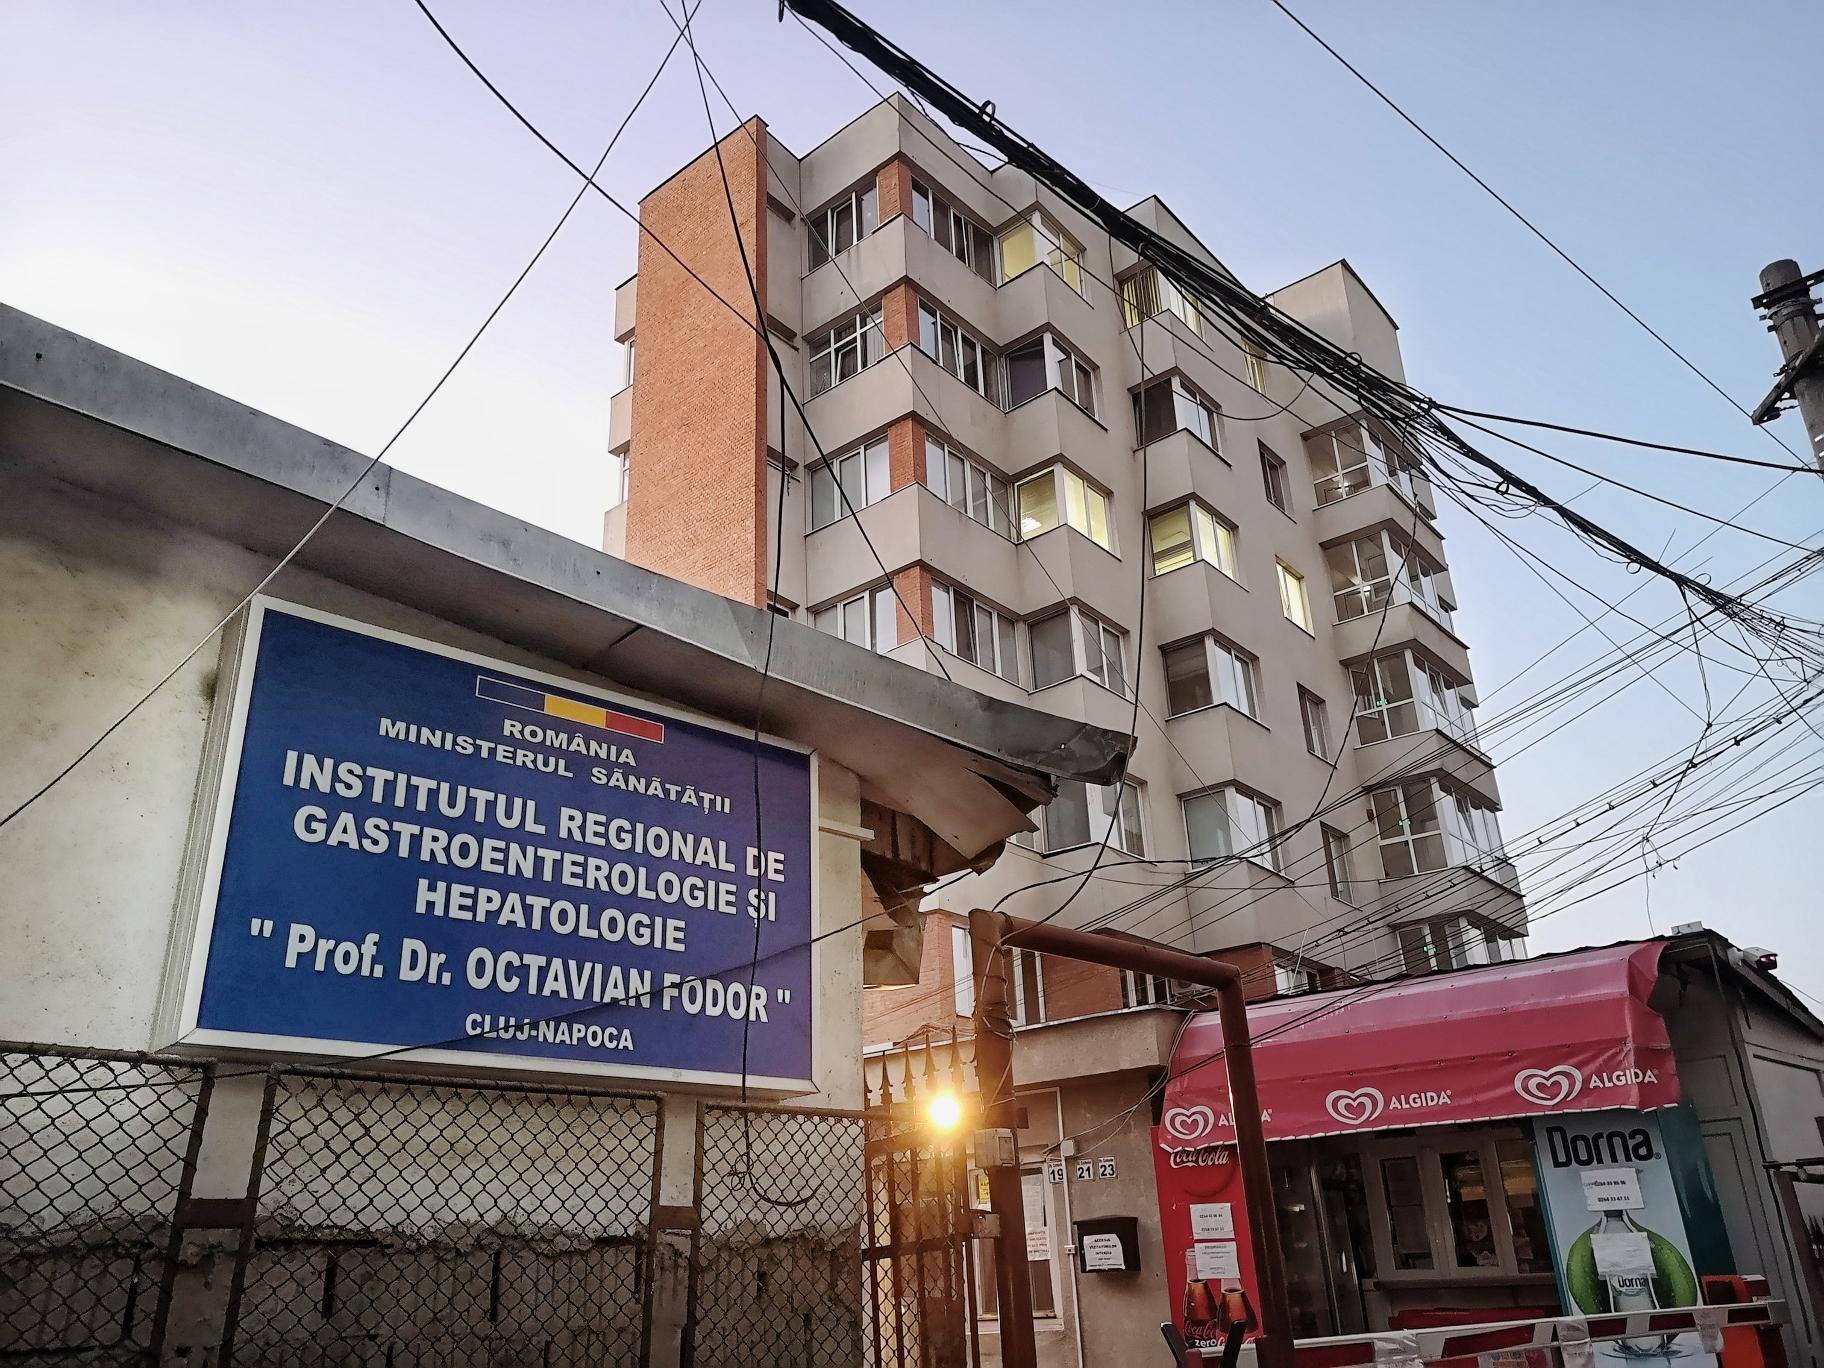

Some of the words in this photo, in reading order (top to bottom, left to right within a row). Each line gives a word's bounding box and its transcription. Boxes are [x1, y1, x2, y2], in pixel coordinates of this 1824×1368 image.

[378, 717, 574, 778] MINISTERUL
[502, 718, 637, 767] ROMÂNIA
[282, 749, 546, 835] INSTITUTUL
[559, 806, 736, 873] REGIONAL
[746, 846, 786, 883] DE
[293, 805, 738, 915] GASTROENTEROLOGIE
[415, 878, 686, 952] HEPATOLOGIE
[284, 922, 384, 978] Prof.
[399, 937, 451, 986] Dr.
[466, 946, 652, 1009] OCTAVIAN
[662, 972, 769, 1023] FODOR
[464, 1012, 634, 1051] CLUJ-NAPOCA
[1589, 1069, 1658, 1089] ALGIDA
[1389, 1091, 1452, 1110] ALGIDA
[1546, 1125, 1654, 1168] Dorna
[1050, 1168, 1064, 1181] 19
[1077, 1165, 1092, 1179] 21
[1100, 1163, 1116, 1177] 23
[1194, 1338, 1217, 1347] zero
